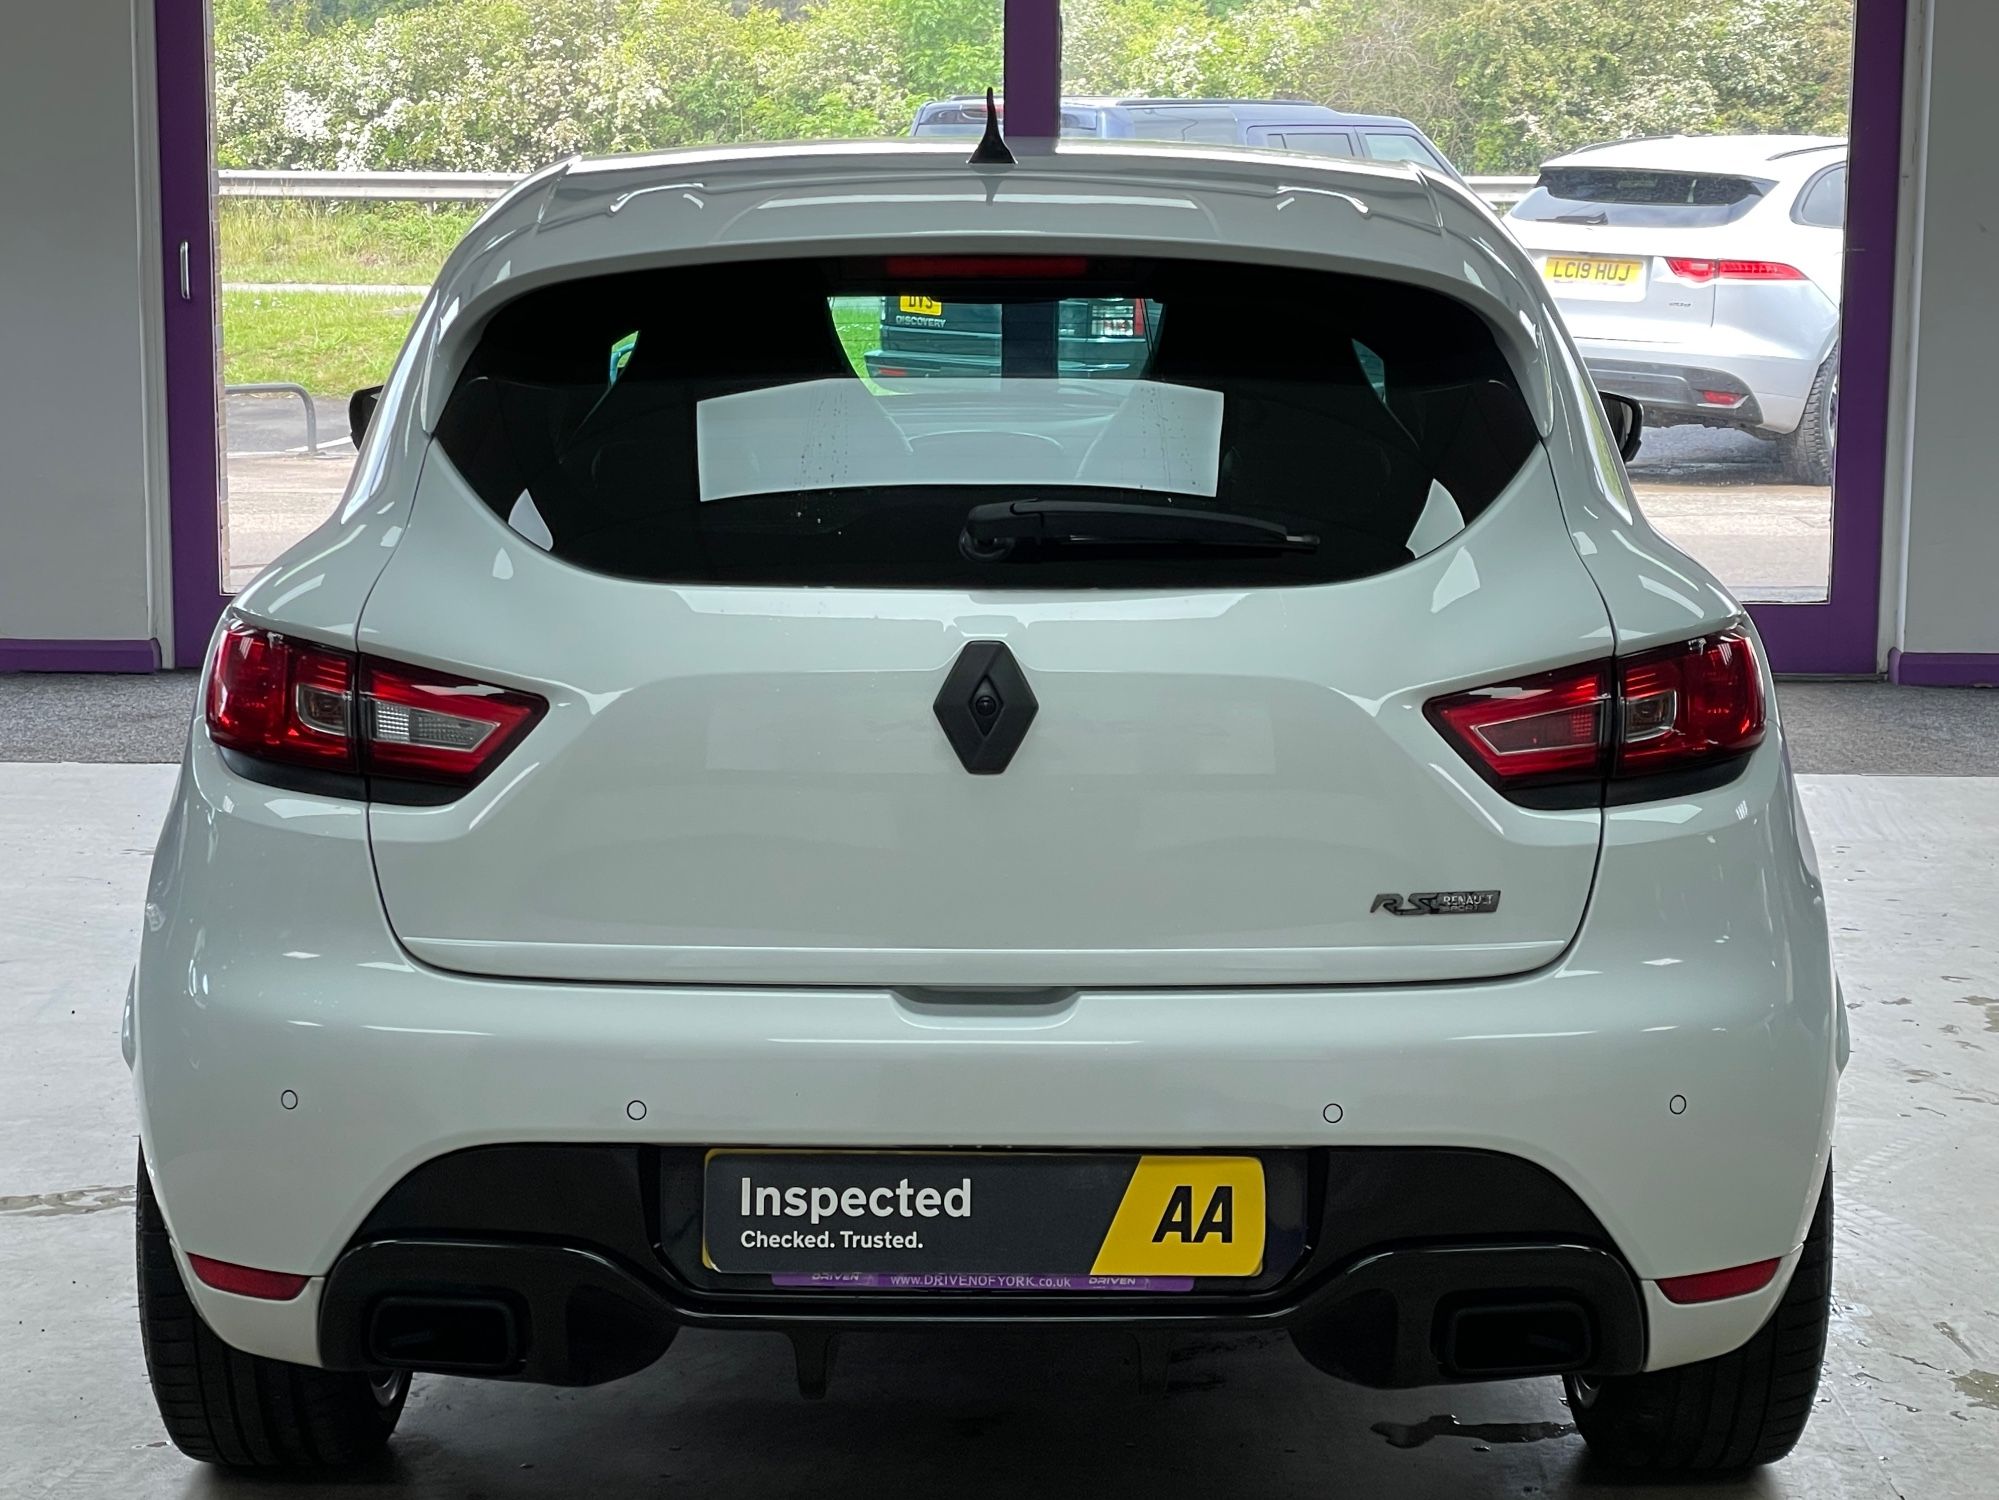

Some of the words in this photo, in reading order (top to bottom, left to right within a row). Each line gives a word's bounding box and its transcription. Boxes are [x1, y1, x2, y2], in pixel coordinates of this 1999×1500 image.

[1553, 261, 1592, 279] LC19
[1595, 264, 1631, 281] HUJ
[895, 315, 947, 328] DISCOVERY
[741, 1177, 972, 1224] Inspected
[1152, 1186, 1233, 1243] AA
[741, 1230, 836, 1249] Checked.
[840, 1231, 924, 1249] Trusted.
[890, 1275, 1071, 1288] www.DRIVENOFYORK.co.uk
[1088, 1277, 1136, 1286] DRIVEN
